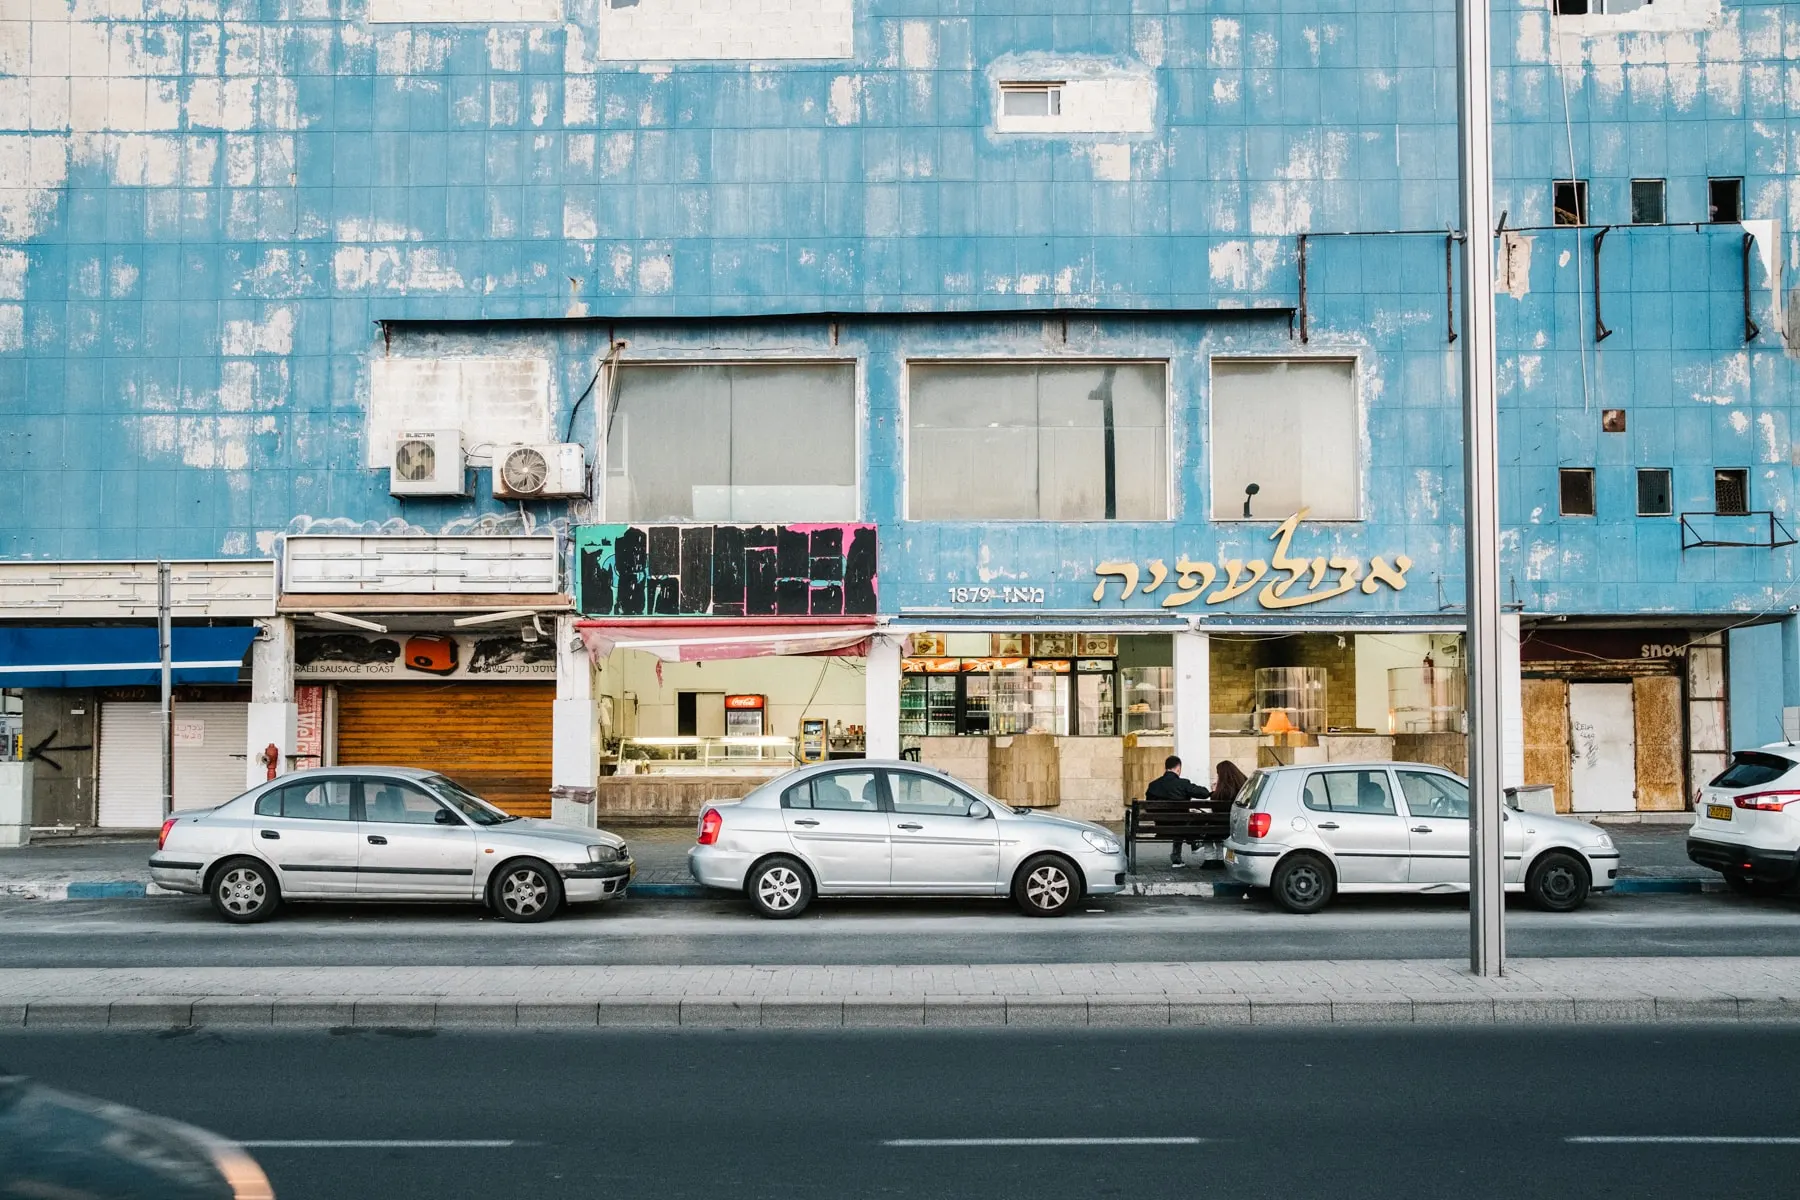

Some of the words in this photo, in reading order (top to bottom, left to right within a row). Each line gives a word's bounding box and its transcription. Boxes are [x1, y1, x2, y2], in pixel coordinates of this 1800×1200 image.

[1641, 644, 1688, 657] snow
[295, 665, 318, 673] RAELI
[320, 665, 362, 673] SAUSAGE
[366, 665, 395, 673] TOAST
